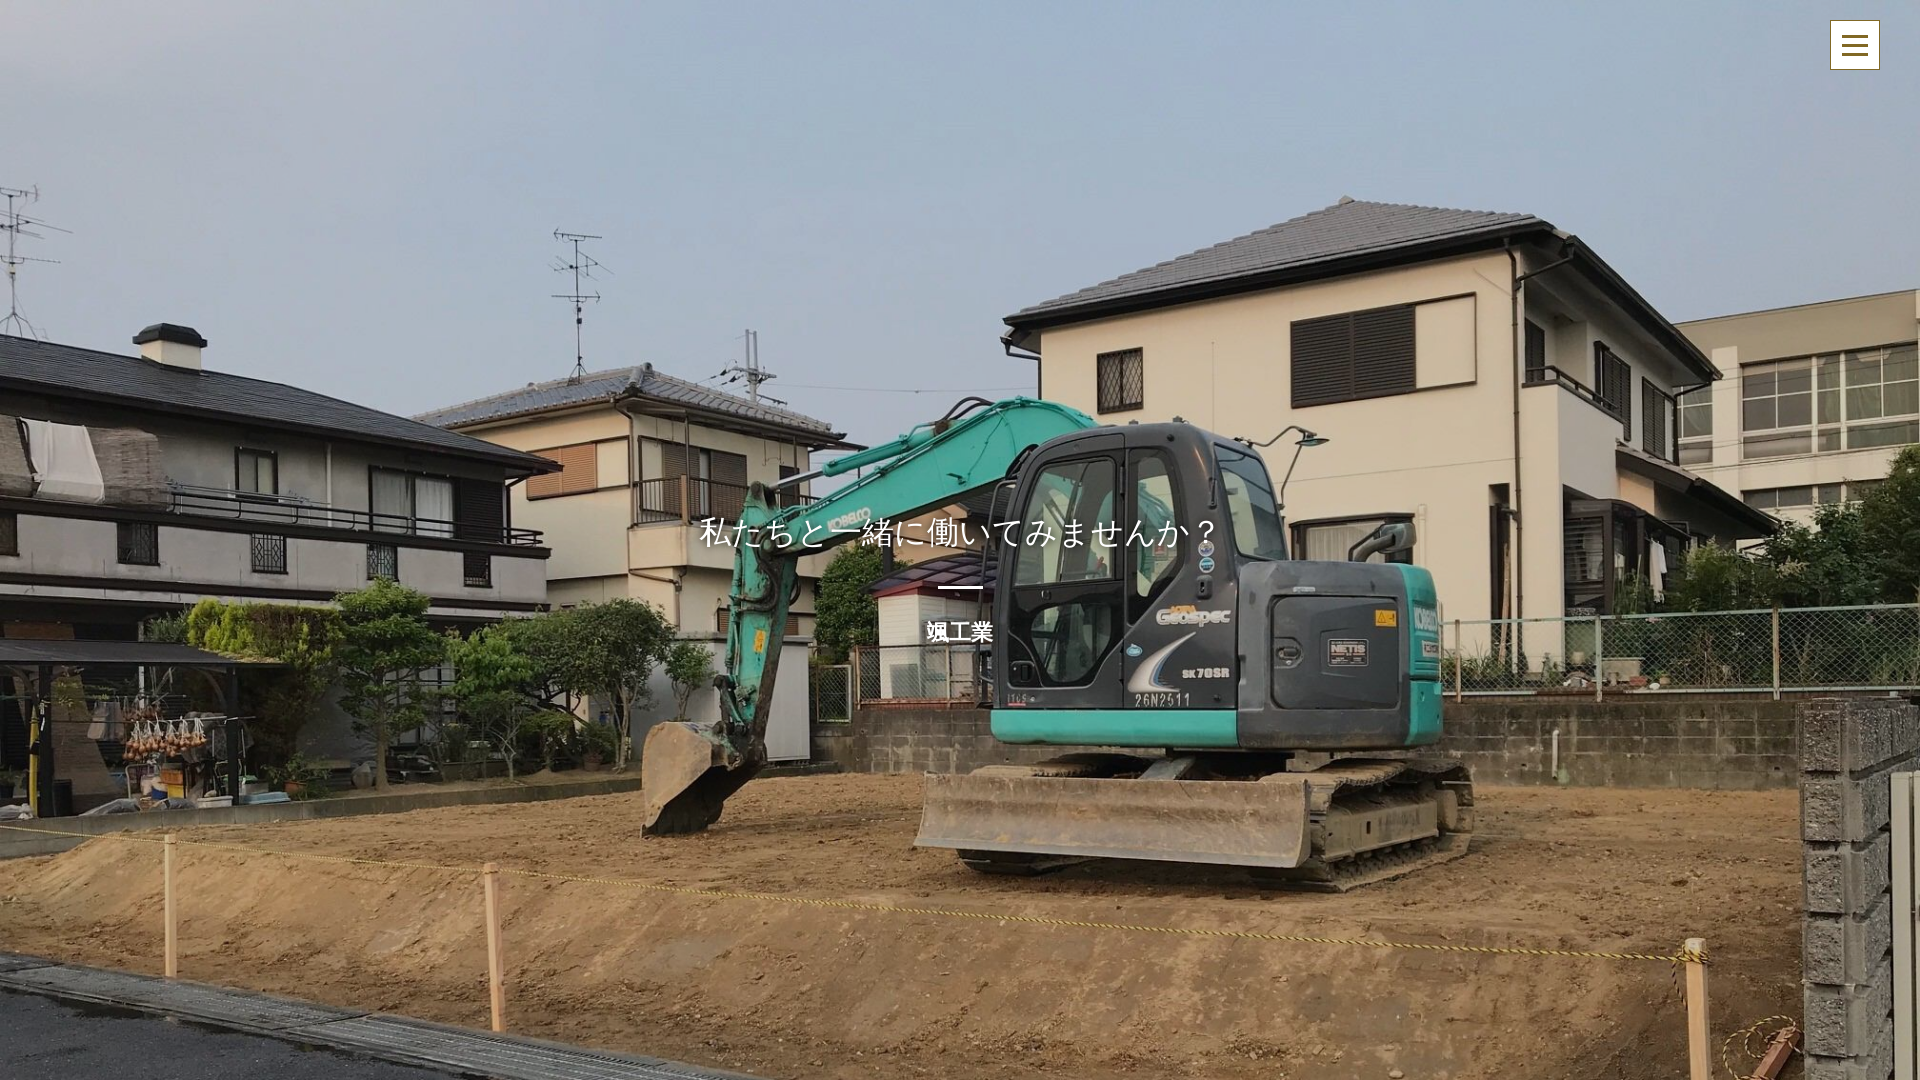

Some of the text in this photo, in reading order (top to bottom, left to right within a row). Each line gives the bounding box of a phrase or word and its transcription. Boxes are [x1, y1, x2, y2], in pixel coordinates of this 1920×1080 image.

[827, 507, 871, 532] KOBELCO
[1331, 644, 1366, 653] NETIS
[1135, 692, 1190, 707] 26N2511
